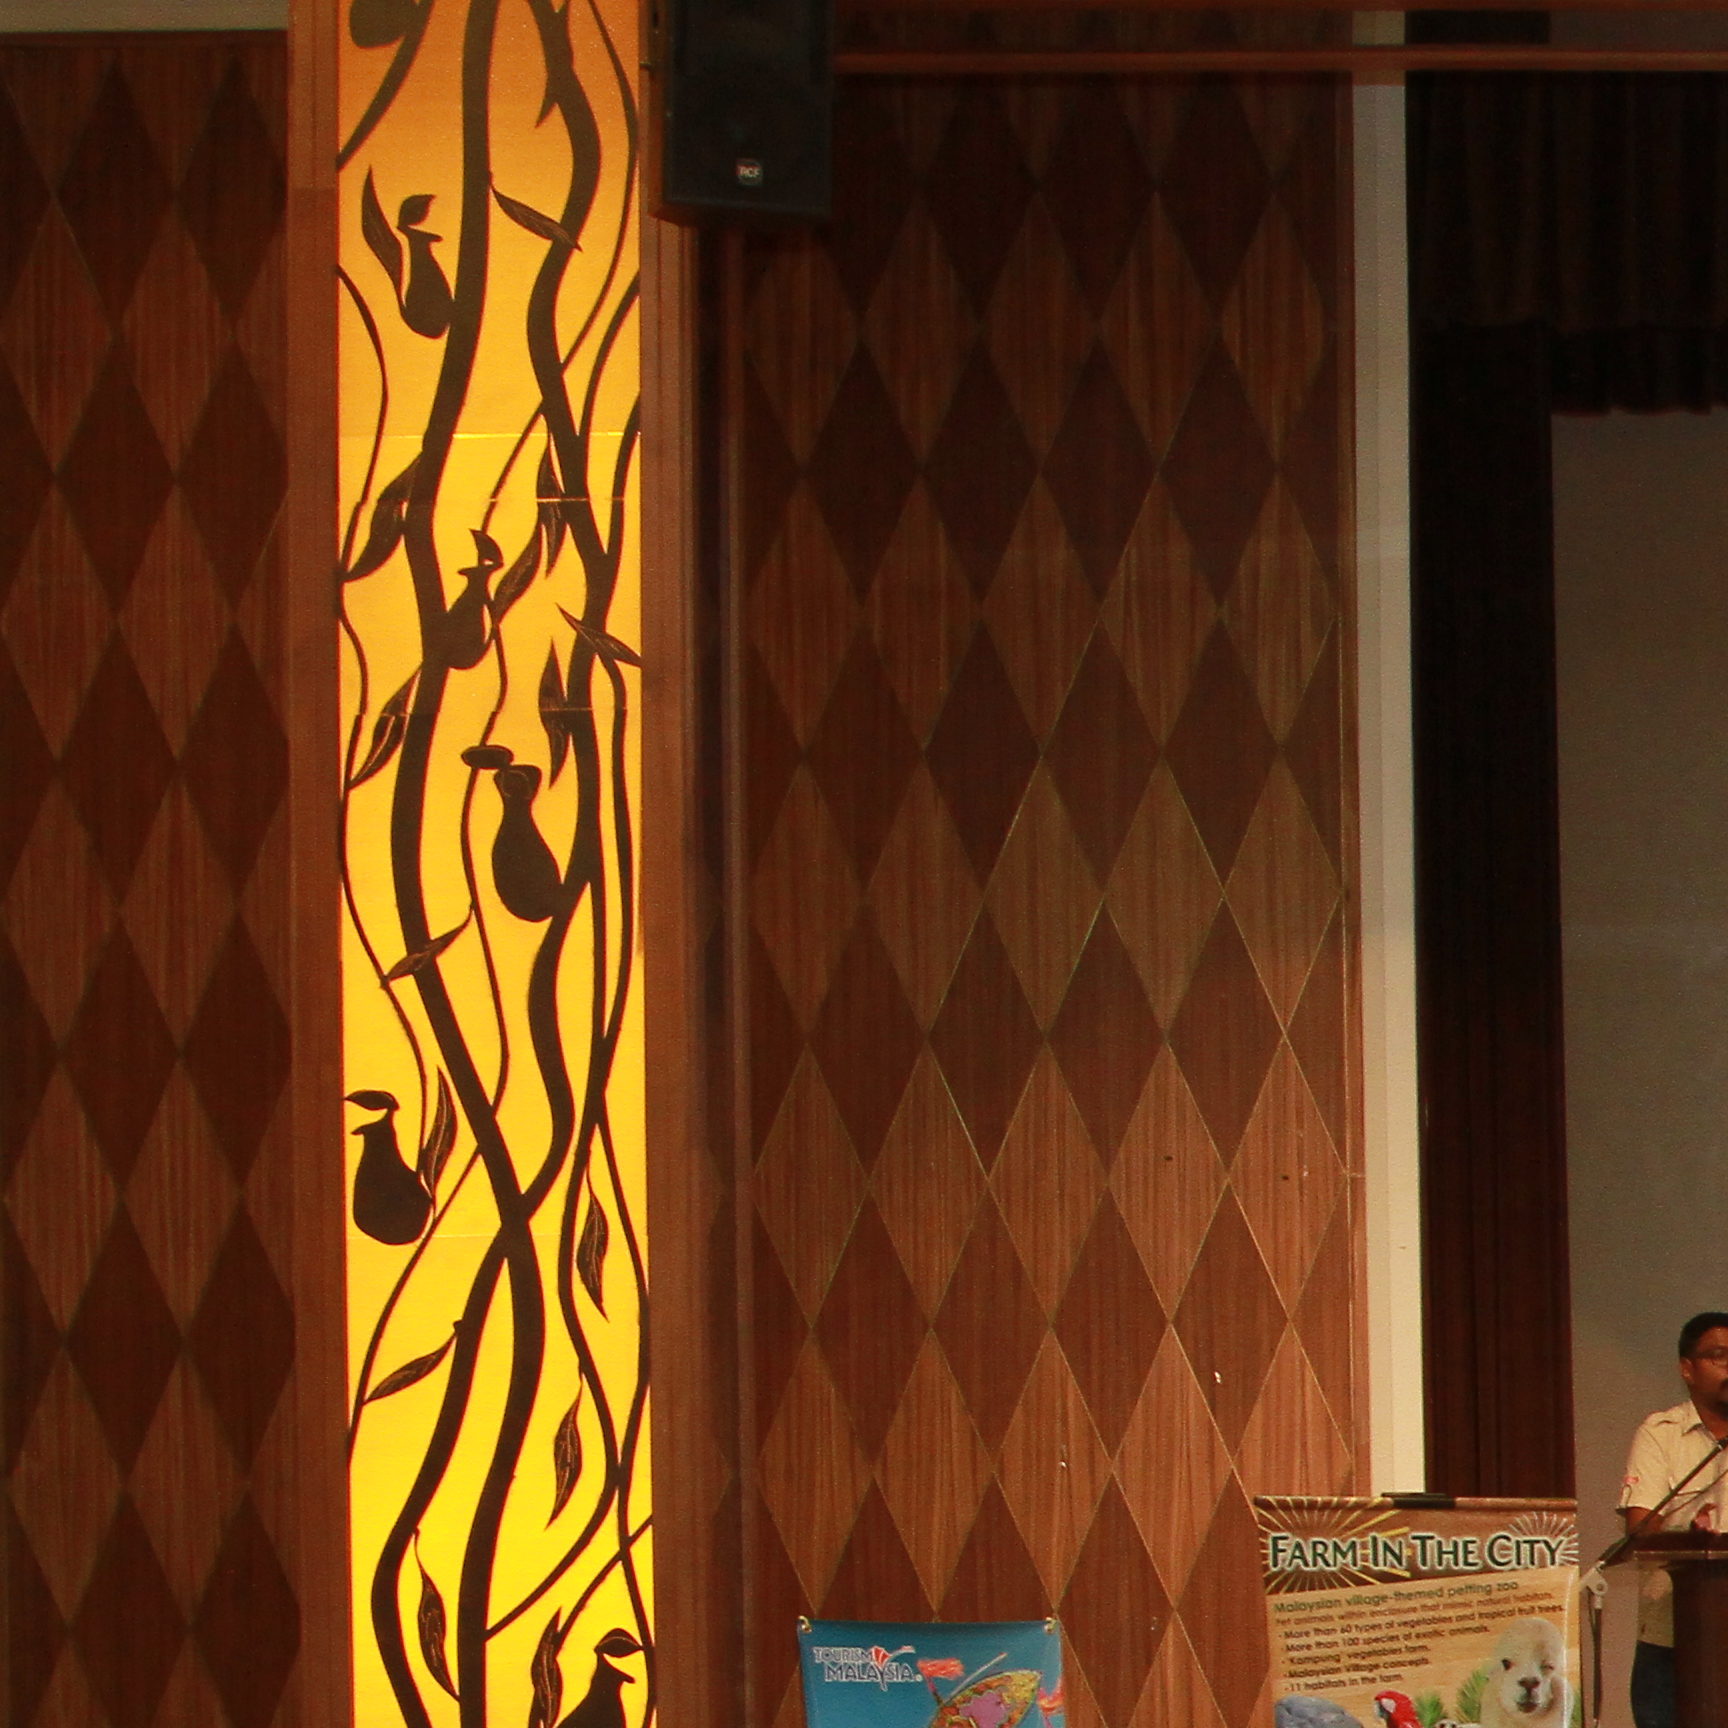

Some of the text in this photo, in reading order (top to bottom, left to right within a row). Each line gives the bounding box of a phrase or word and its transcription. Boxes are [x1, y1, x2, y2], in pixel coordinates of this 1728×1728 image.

[1270, 1533, 1567, 1568] FARM IN THE CITY
[1497, 1582, 1518, 1592] zoo
[813, 1646, 873, 1664] TOURISM
[825, 1661, 915, 1692] MALAYSIA
